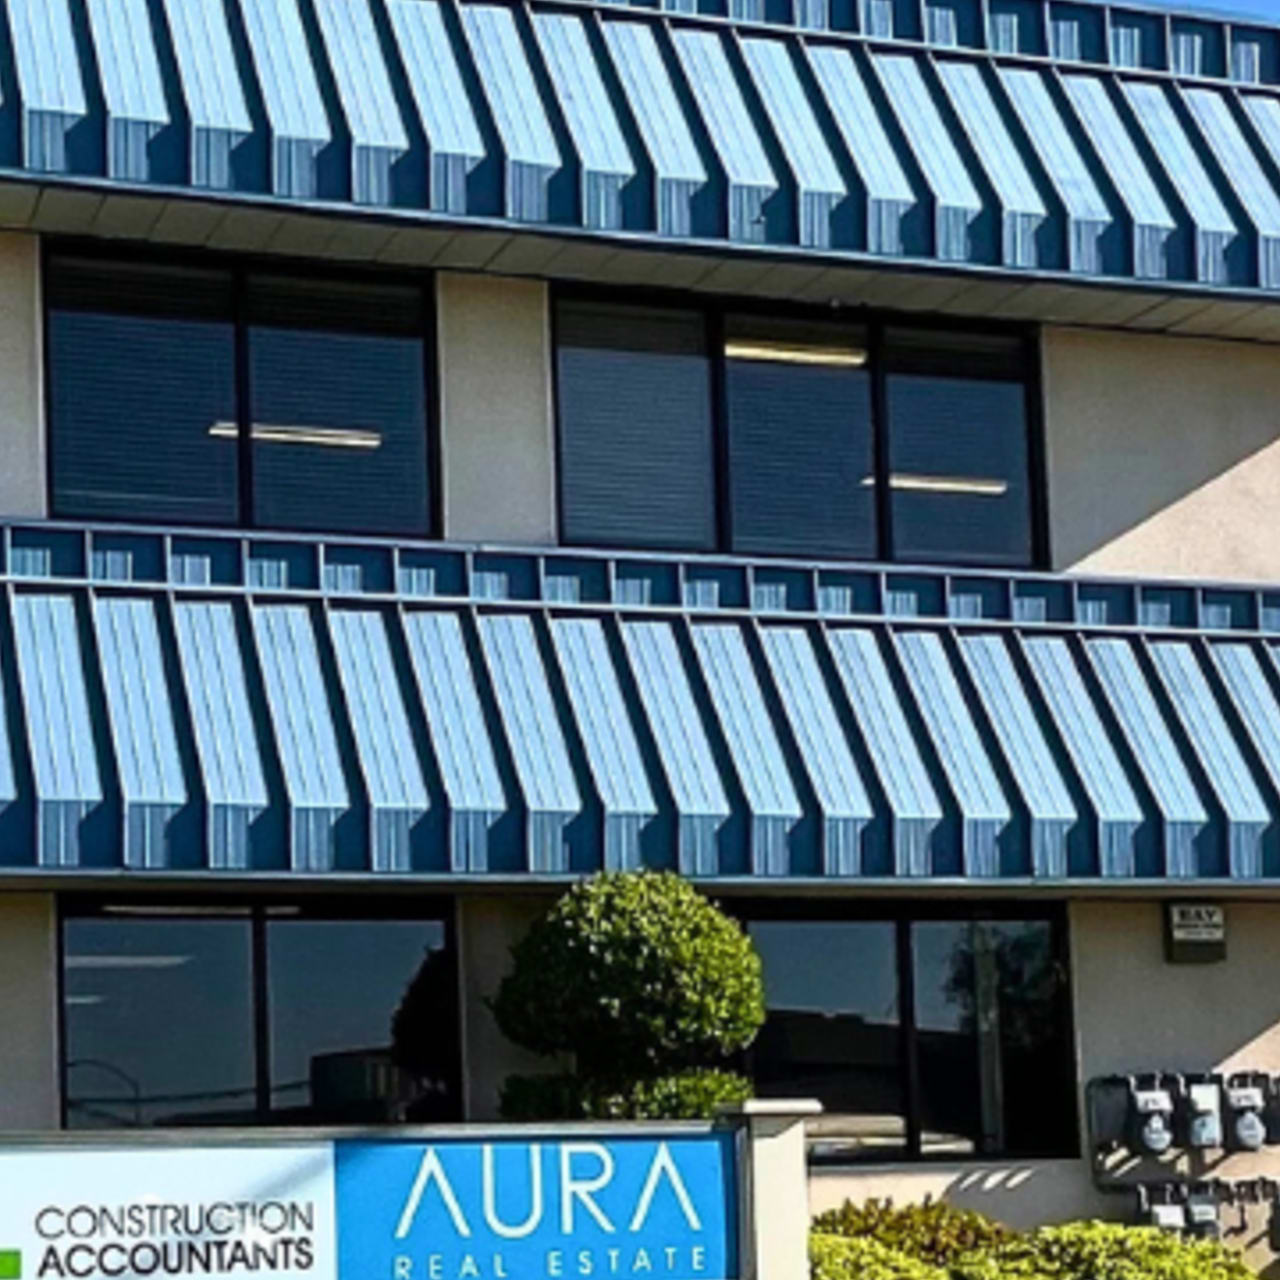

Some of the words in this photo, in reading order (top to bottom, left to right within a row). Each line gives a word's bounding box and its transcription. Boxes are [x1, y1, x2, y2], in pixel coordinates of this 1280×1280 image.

[394, 1141, 702, 1239] AURA
[34, 1201, 315, 1240] CONSTRUCTION
[37, 1236, 315, 1279] ACCOUNTANTS
[394, 1253, 508, 1280] REAL
[547, 1246, 706, 1276] ESTATE
